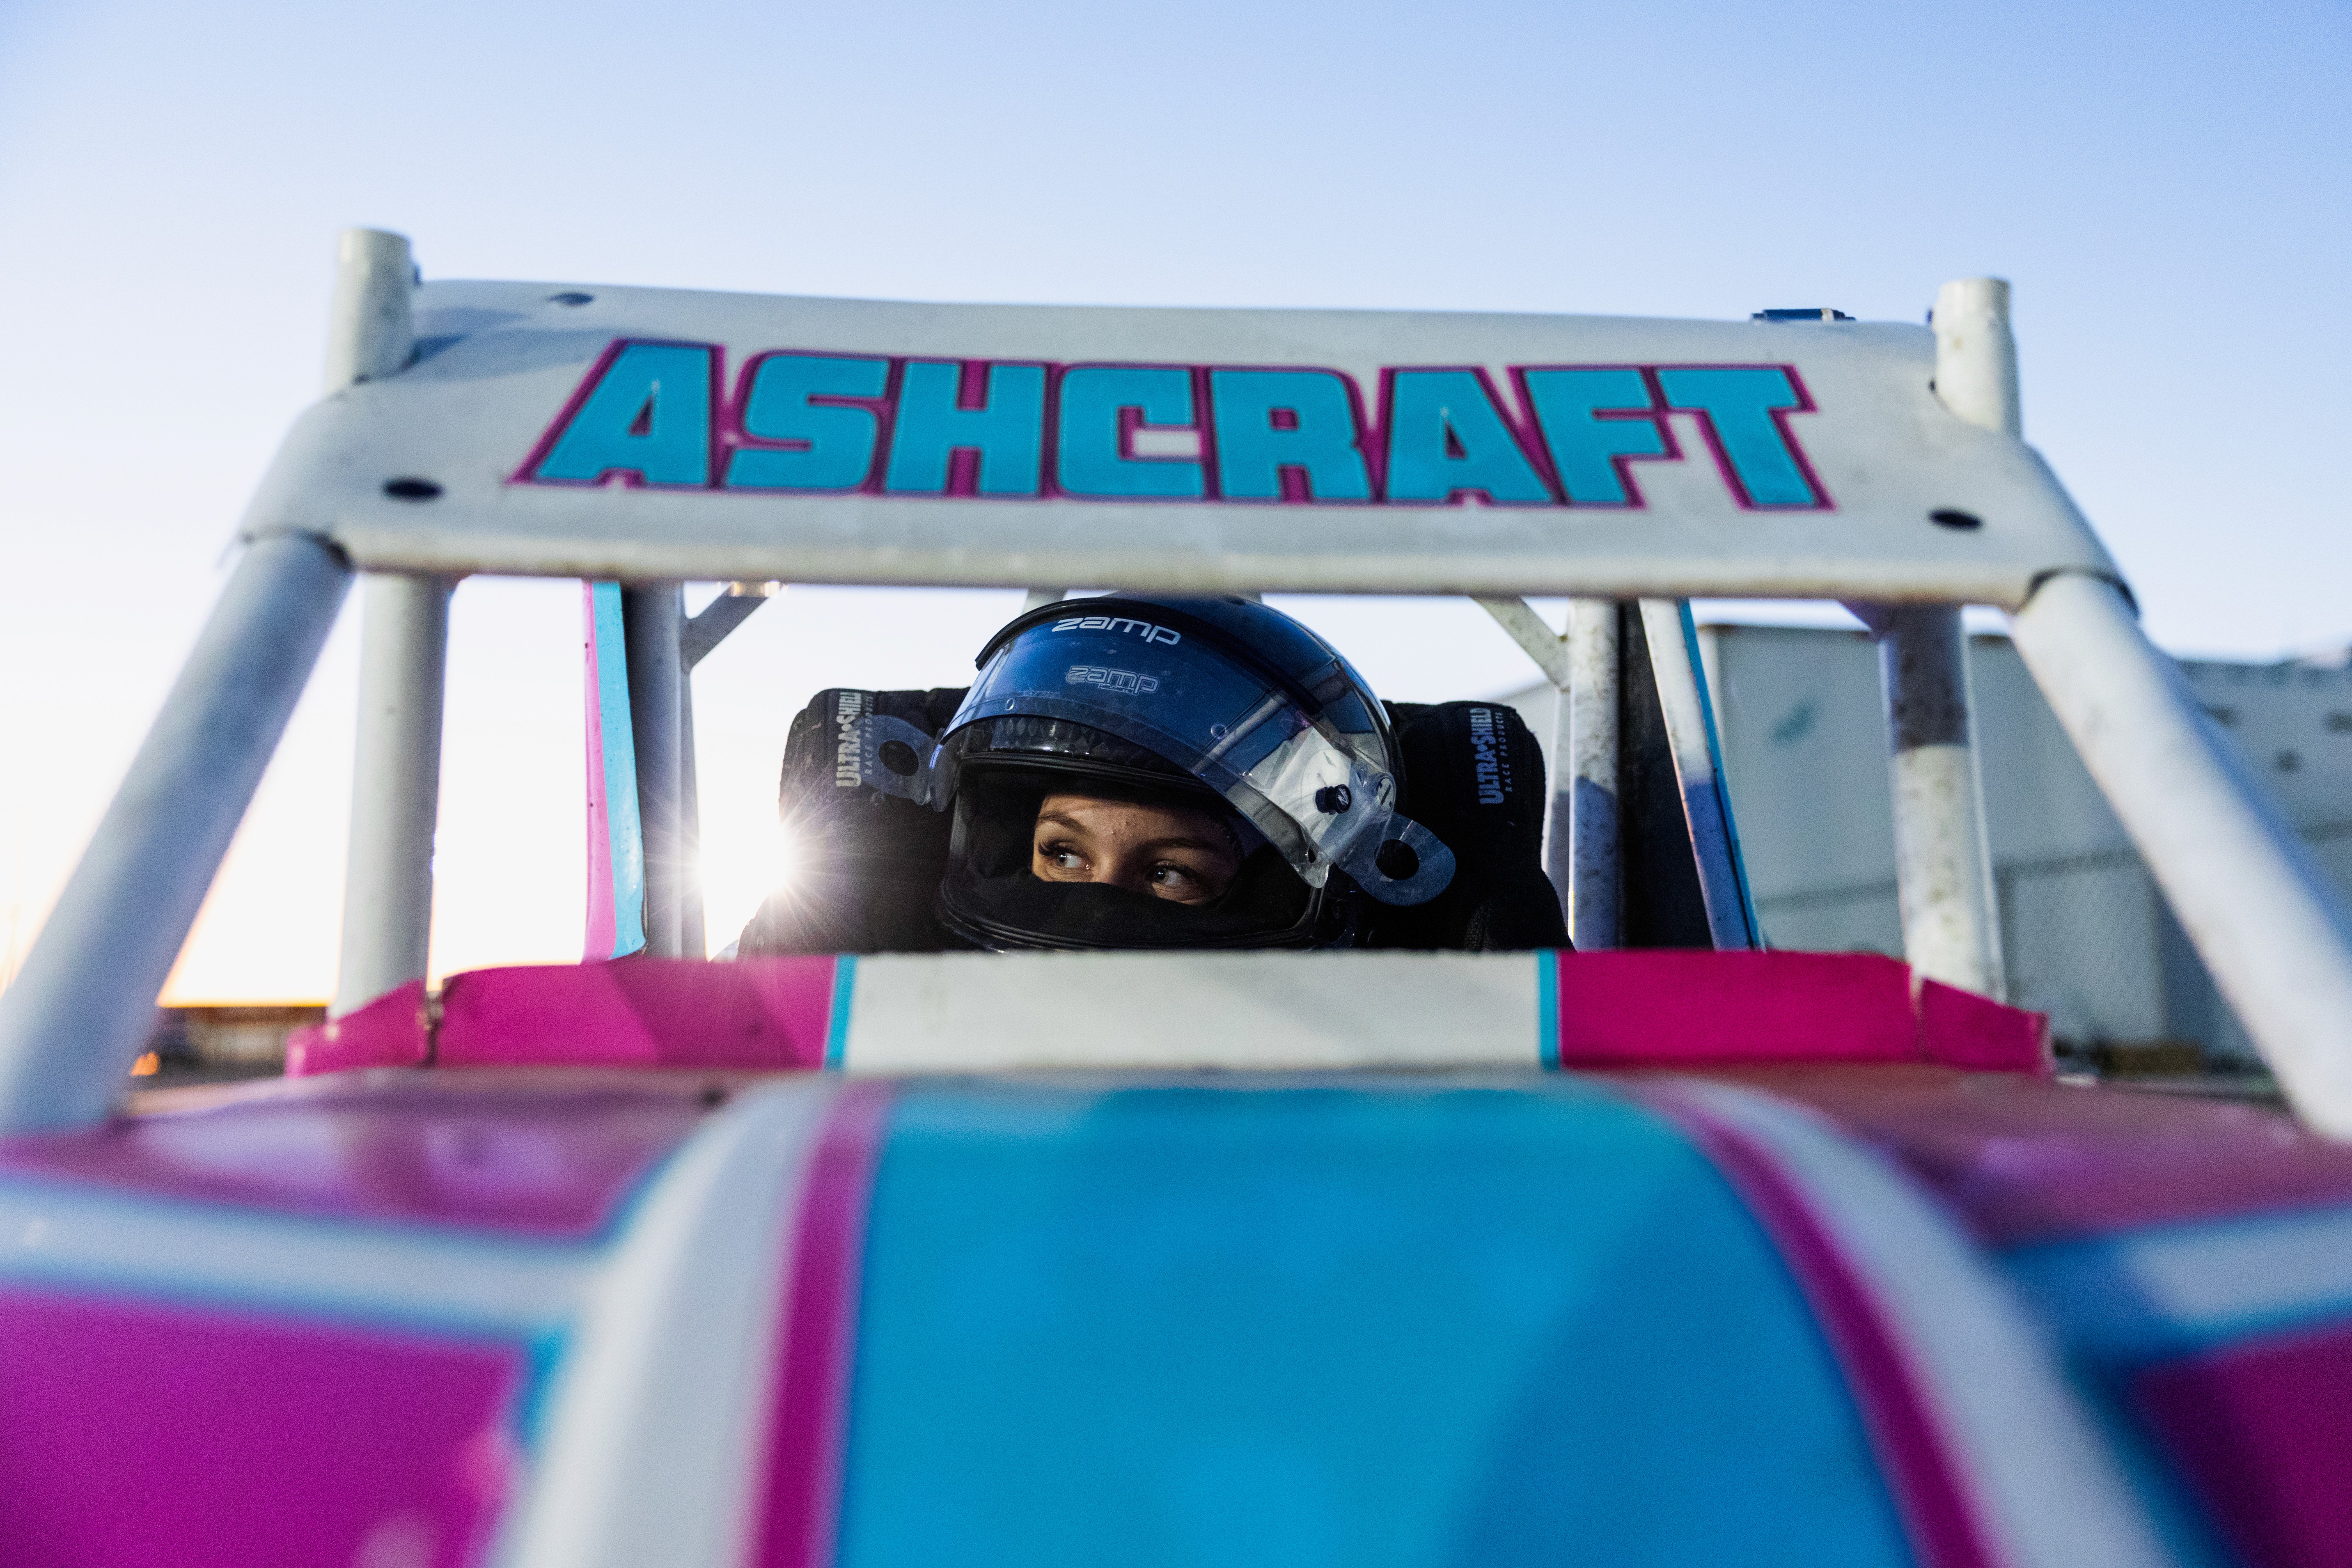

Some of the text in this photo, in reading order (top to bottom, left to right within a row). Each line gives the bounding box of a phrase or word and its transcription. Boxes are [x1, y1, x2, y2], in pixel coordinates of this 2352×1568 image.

[504, 337, 1837, 512] ASHCRAFT
[1051, 617, 1181, 645] zamp
[1066, 665, 1159, 695] zamp
